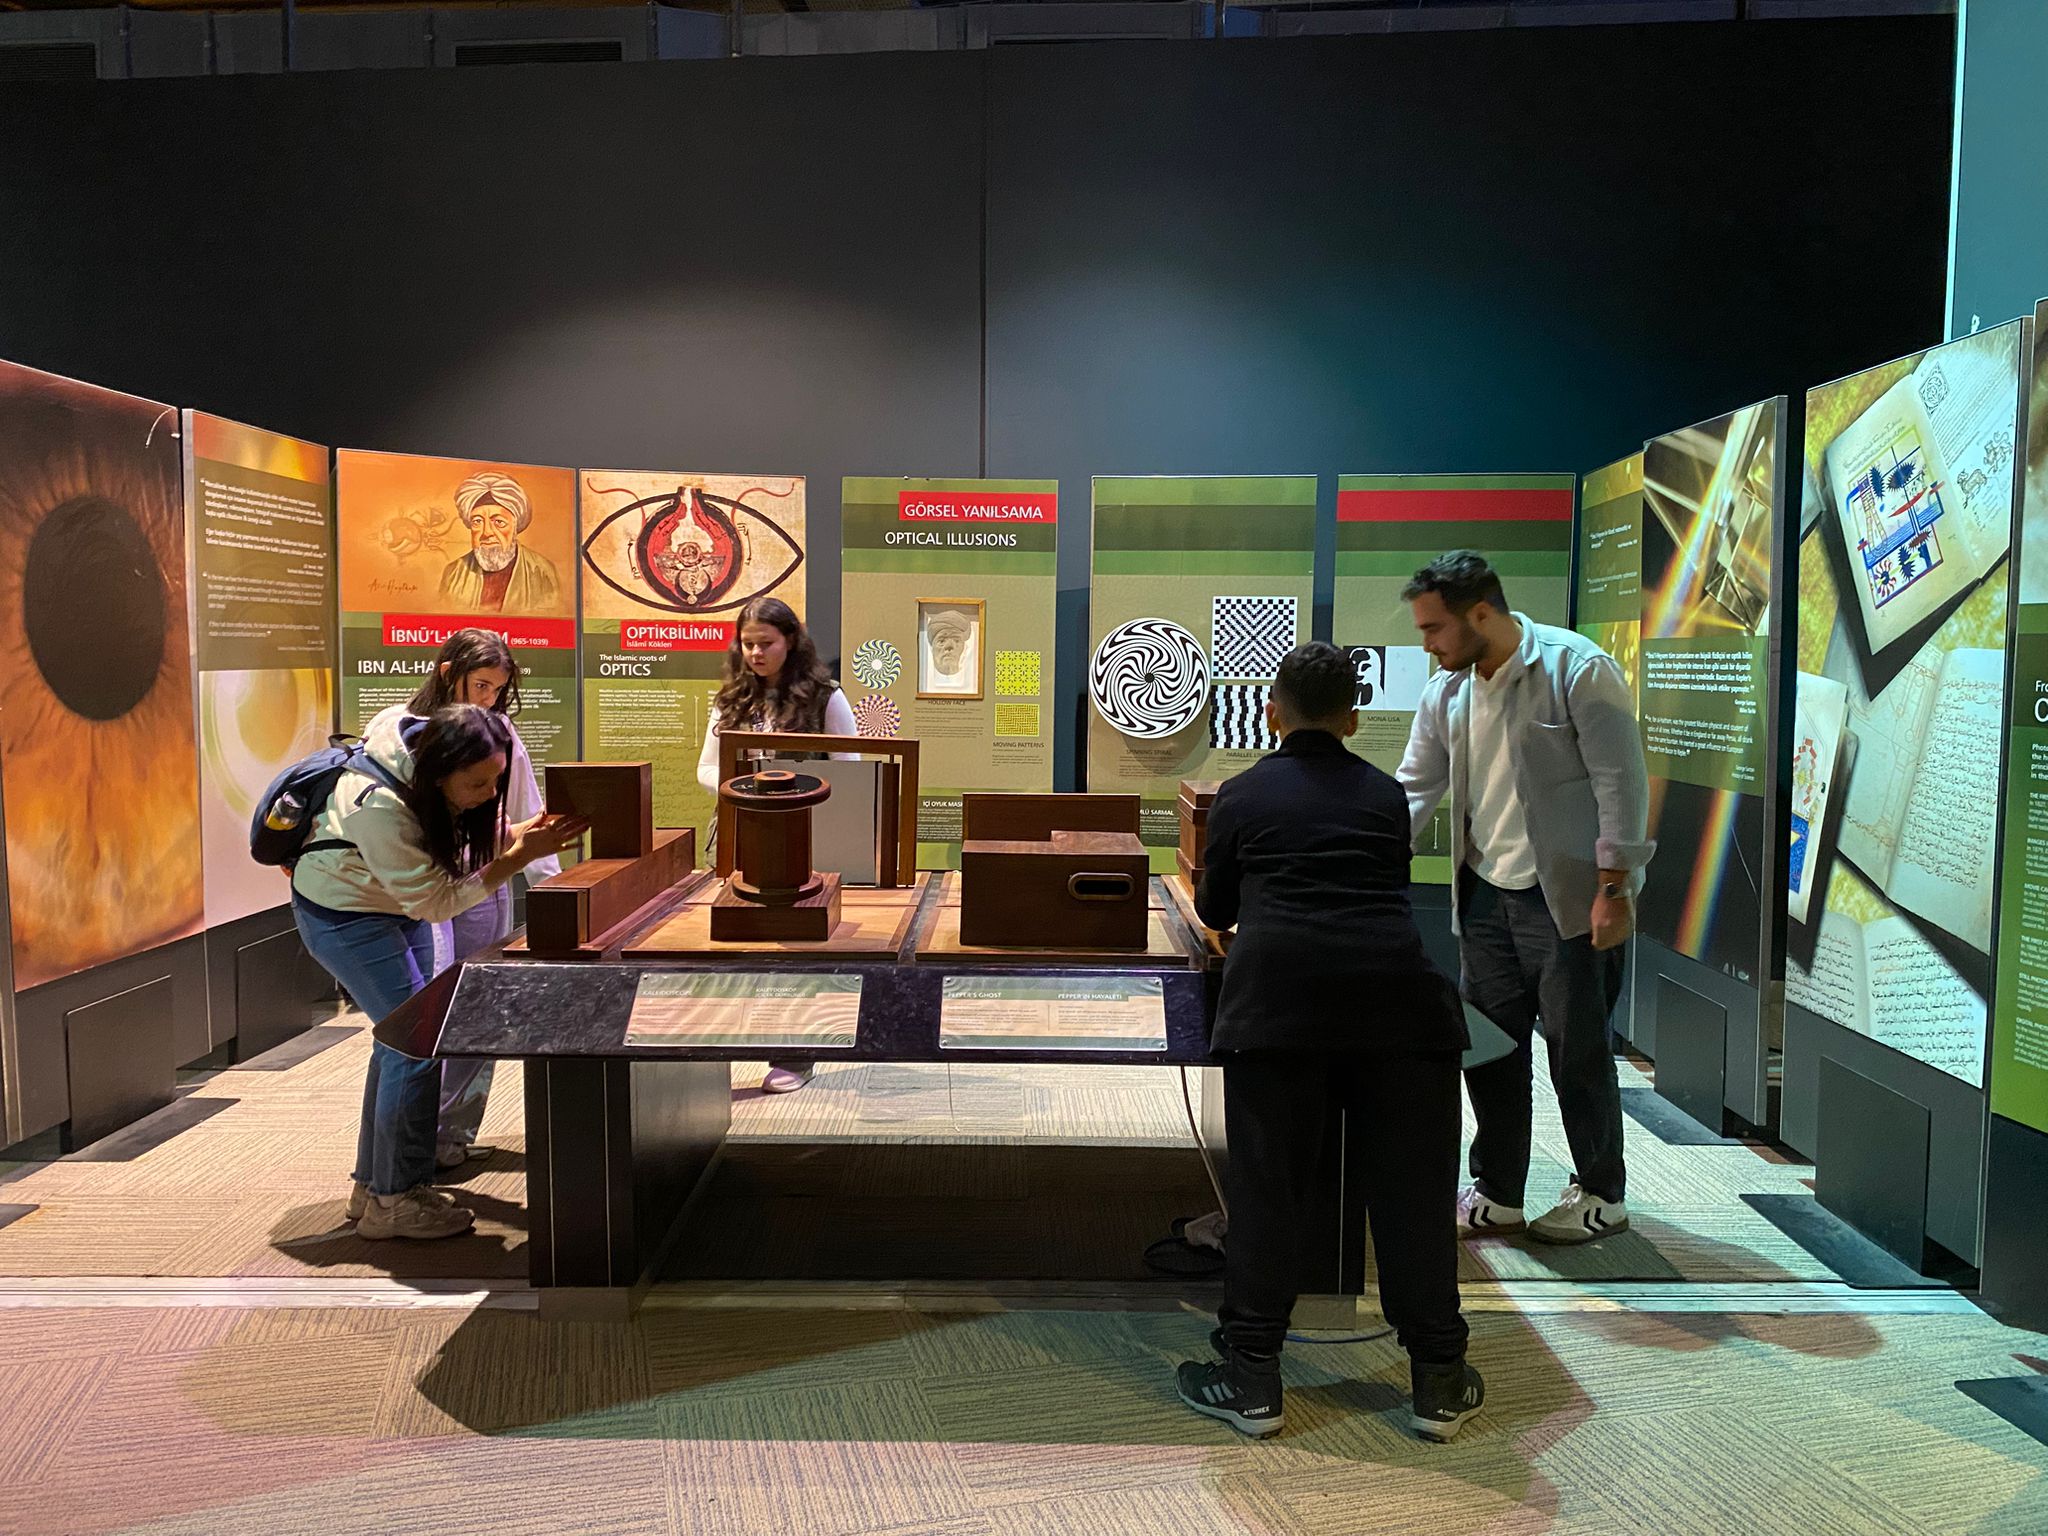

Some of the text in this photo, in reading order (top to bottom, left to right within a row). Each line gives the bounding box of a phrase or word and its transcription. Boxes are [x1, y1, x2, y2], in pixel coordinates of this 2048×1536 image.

[904, 501, 1043, 519] GÖRSEL YANILSAMA
[884, 531, 1017, 547] OPTICAL ILLUSIONS
[626, 624, 723, 641] OPTİKBİLİMİN
[510, 638, 549, 646] (965-1039)
[613, 654, 638, 662] Islamic
[358, 660, 385, 674] IBN
[599, 663, 652, 676] OPTICS
